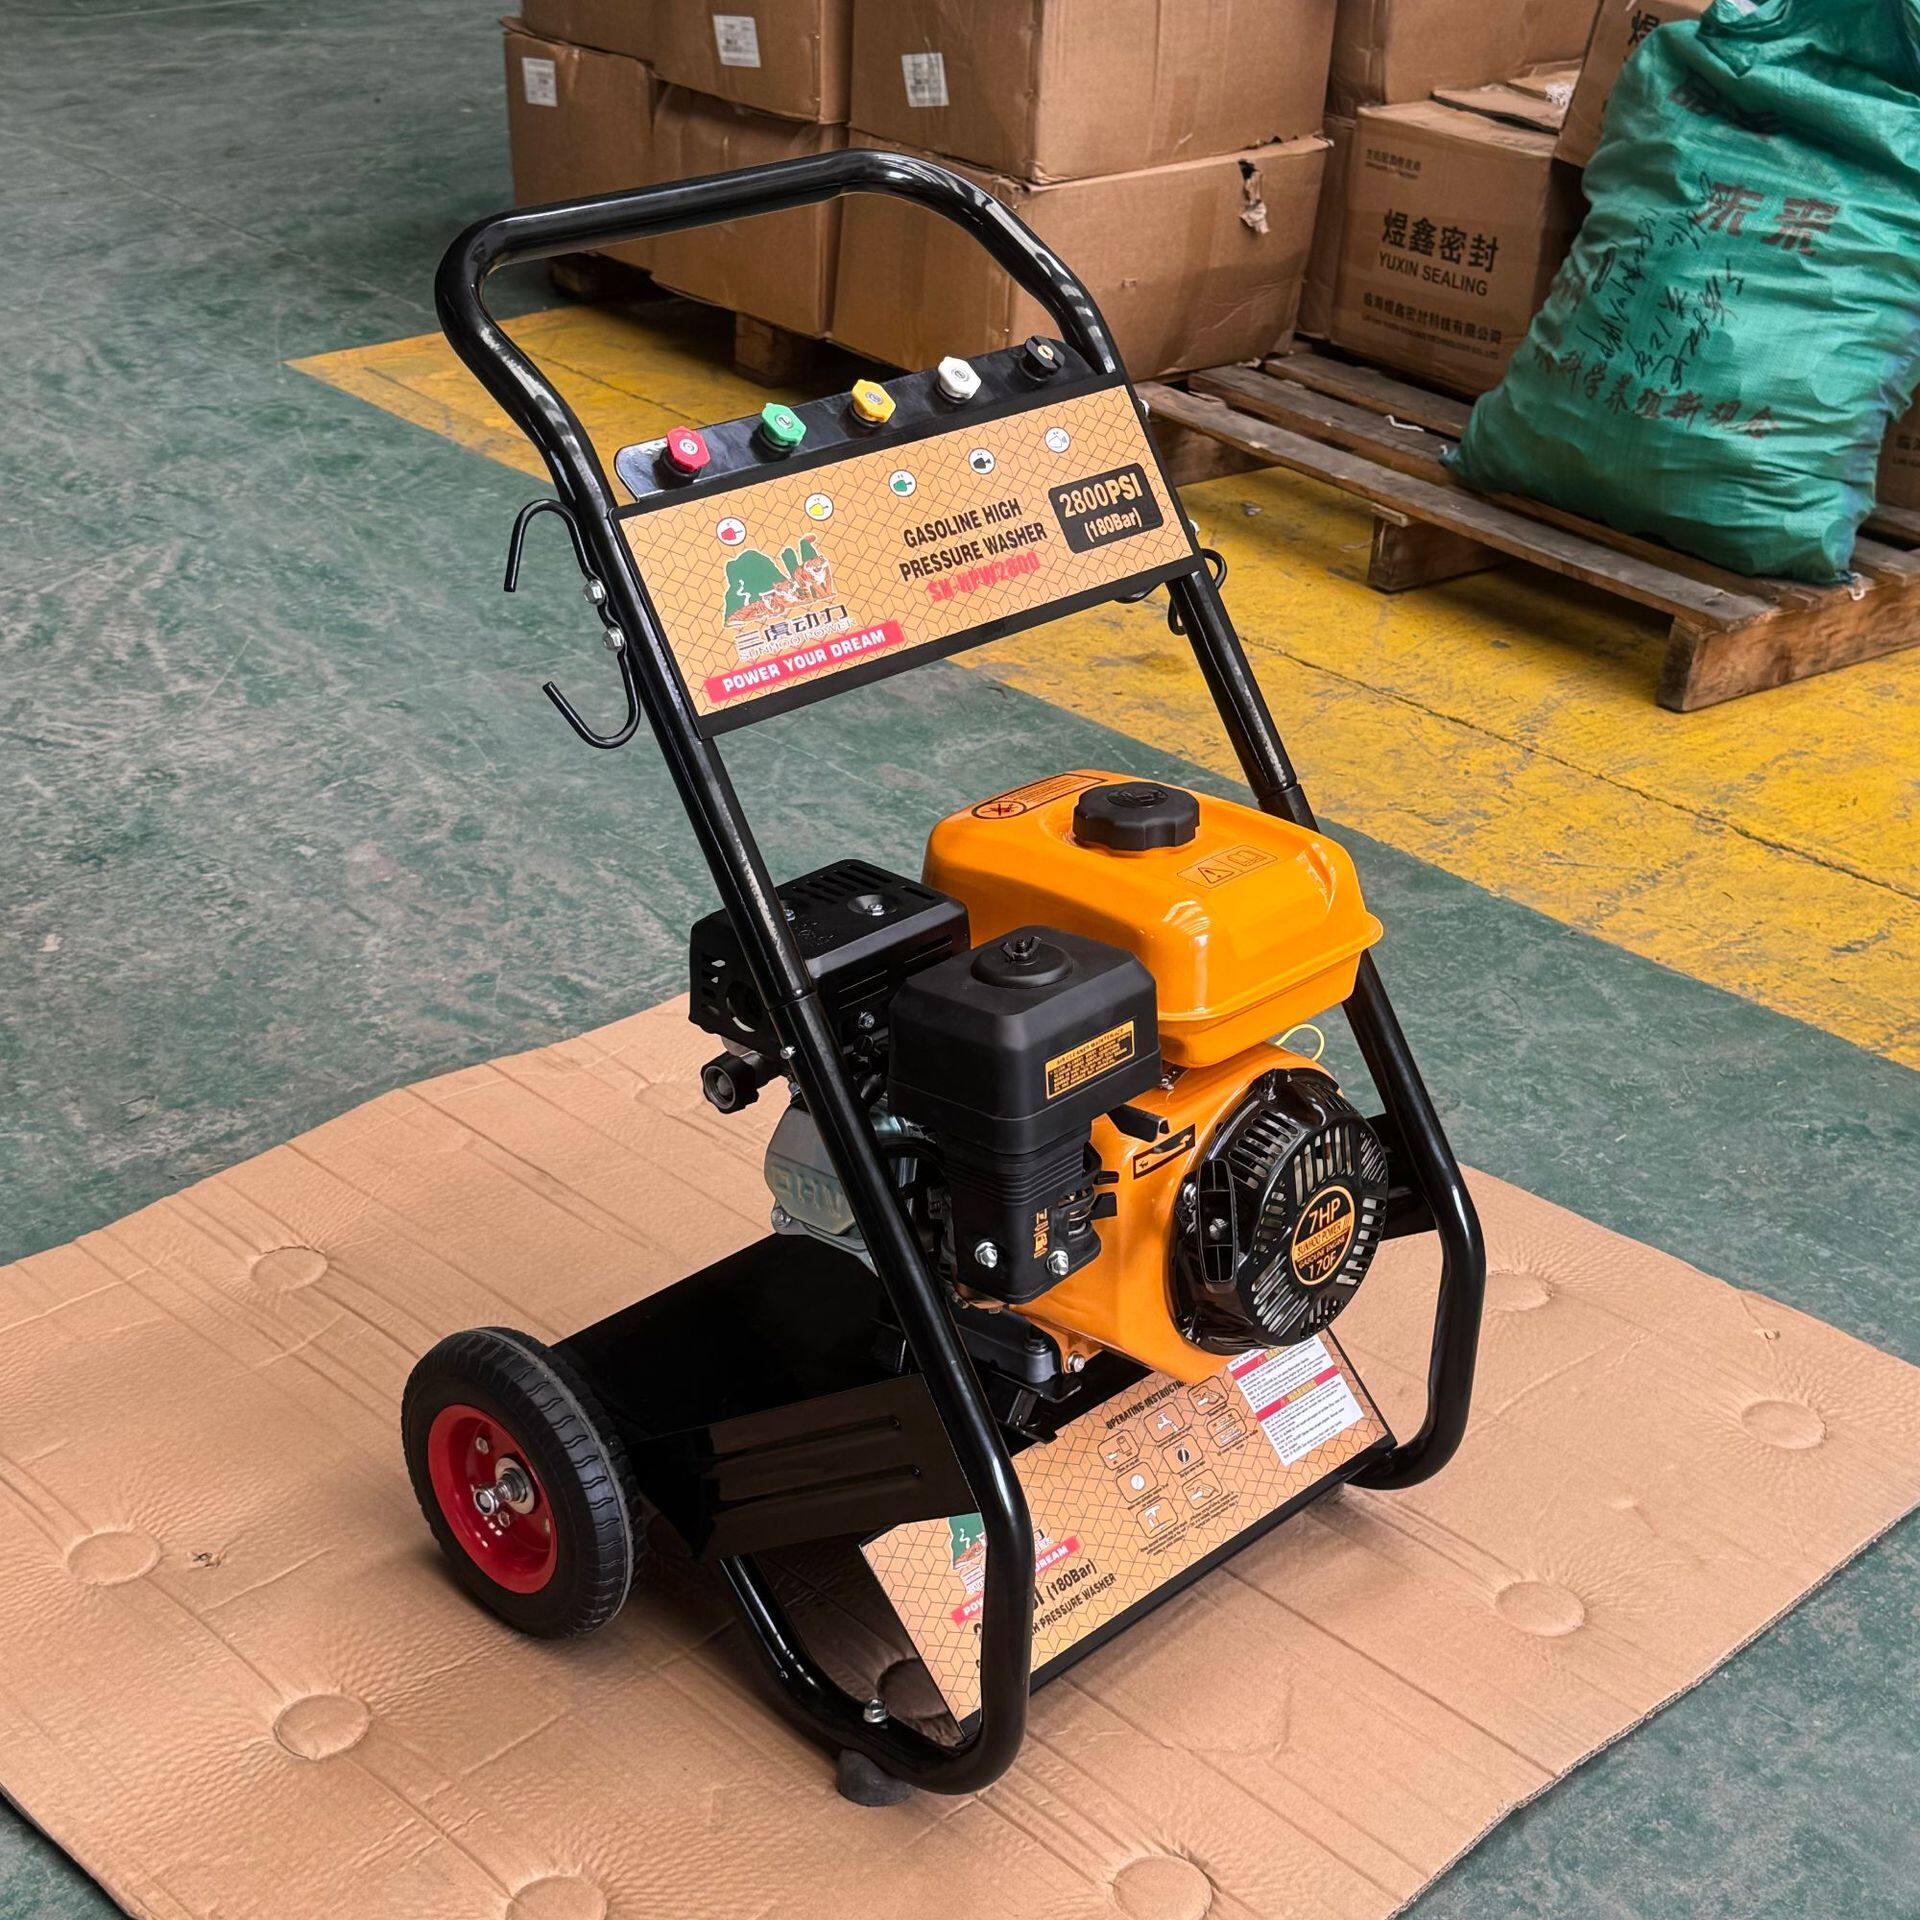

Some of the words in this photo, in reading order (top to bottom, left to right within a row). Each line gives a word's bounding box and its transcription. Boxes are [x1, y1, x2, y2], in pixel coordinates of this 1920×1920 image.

[1381, 208, 1499, 273] 煜鑫密封
[1378, 250, 1420, 277] YUXIN
[1422, 264, 1488, 296] SEALING
[1059, 472, 1144, 519] 2800PSI
[903, 509, 983, 549] GASOLINE
[981, 497, 1023, 526] HIGH
[1083, 507, 1143, 544] (180Bar)
[899, 540, 984, 582] PRESSURE
[982, 521, 1048, 557] WASHER
[735, 604, 849, 651] 三虎动力
[722, 663, 781, 693] POWER
[783, 649, 828, 672] YOUR
[831, 628, 887, 658] DREAM
[1308, 1197, 1341, 1235] 7HP
[1309, 1250, 1337, 1279] 170F
[1105, 1401, 1146, 1430] OPERATING
[1041, 1594, 1084, 1629] PRESSURE
[1081, 1572, 1117, 1601] WASHER
[1046, 1558, 1098, 1602] (180Bar)
